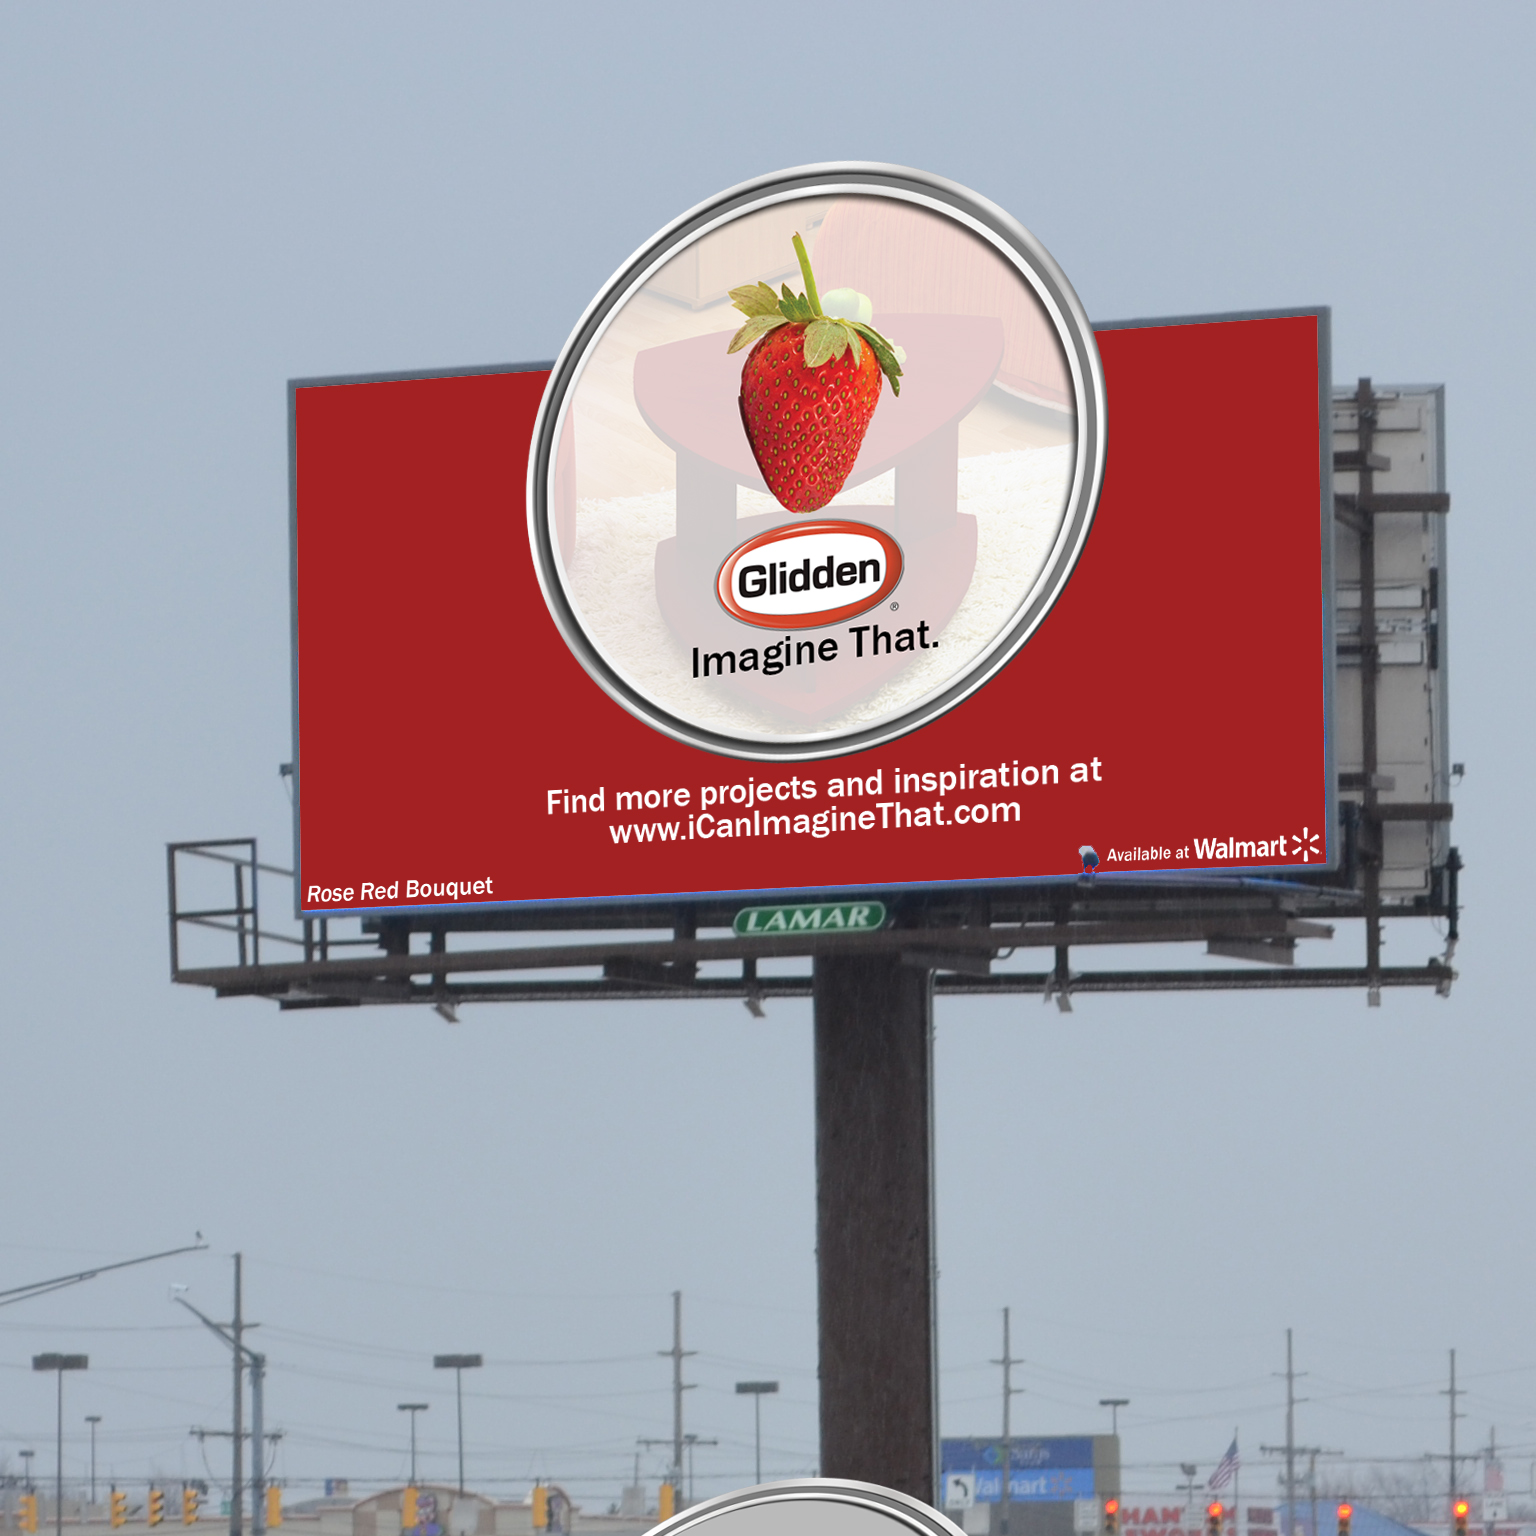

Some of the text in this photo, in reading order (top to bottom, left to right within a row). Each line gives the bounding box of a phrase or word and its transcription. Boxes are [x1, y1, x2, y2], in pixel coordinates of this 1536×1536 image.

[738, 555, 880, 599] Glidden
[692, 620, 939, 678] Imagine That.
[547, 757, 1103, 815] Find more projects and inspiration at
[609, 801, 1021, 844] www.iCanImagineThat.com
[1106, 835, 1287, 862] Available at Walmart
[307, 876, 494, 903] Rose Red Bouquet
[746, 907, 870, 932] LAMAR
